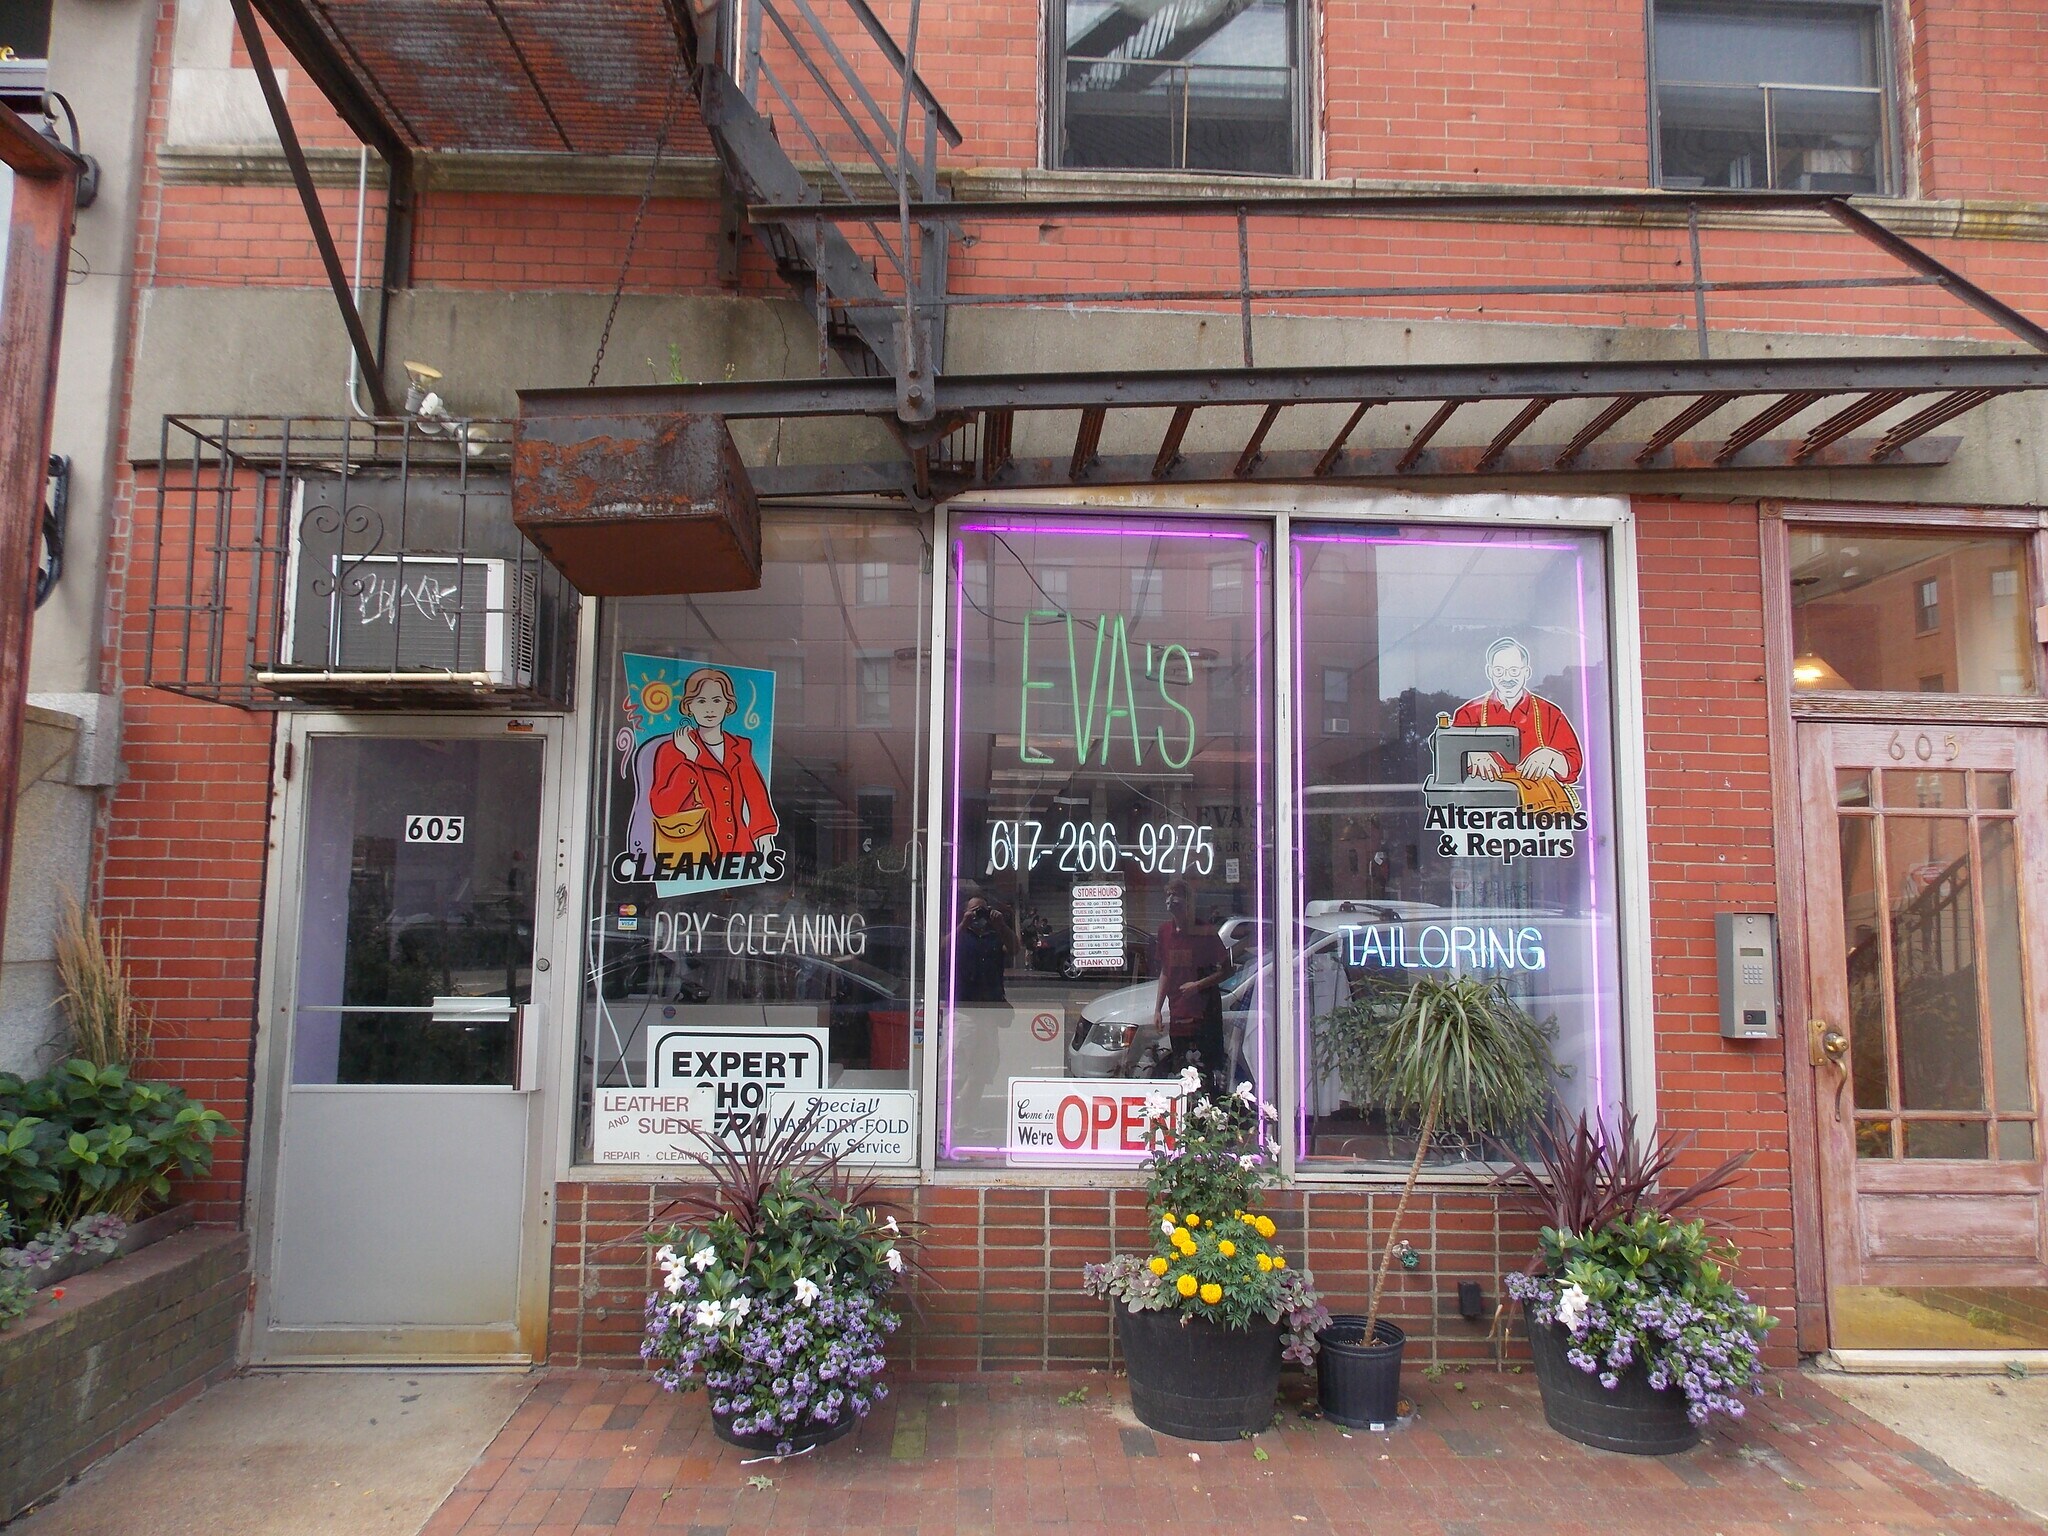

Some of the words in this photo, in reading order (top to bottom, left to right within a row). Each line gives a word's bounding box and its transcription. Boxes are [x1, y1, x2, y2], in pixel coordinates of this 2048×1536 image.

[1888, 730, 1959, 761] 605
[1425, 803, 1588, 830] Alterations
[407, 817, 462, 841] 605
[991, 821, 1213, 875] 617-266-9275
[1438, 834, 1457, 856] &
[1467, 831, 1574, 864] Repairs
[613, 850, 784, 882] CLEANERS
[1077, 888, 1097, 897] STORE
[1098, 887, 1118, 897] HOURS
[653, 911, 711, 953] DRY
[726, 912, 866, 955] CLEANING
[1339, 925, 1546, 969] TAILORING
[1106, 958, 1122, 966] YOU
[672, 1051, 809, 1078] EXPERT
[604, 1096, 689, 1112] LEATHER
[696, 1082, 785, 1109] HO
[805, 1096, 881, 1116] Special!
[1017, 1098, 1043, 1119] Come
[1044, 1109, 1055, 1119] in
[607, 1114, 630, 1130] AND
[638, 1117, 703, 1135] SUEDE
[1018, 1126, 1054, 1145] We're
[603, 1151, 640, 1160] REPAIR
[655, 1151, 709, 1161] CLEANING
[847, 1138, 901, 1154] Service
